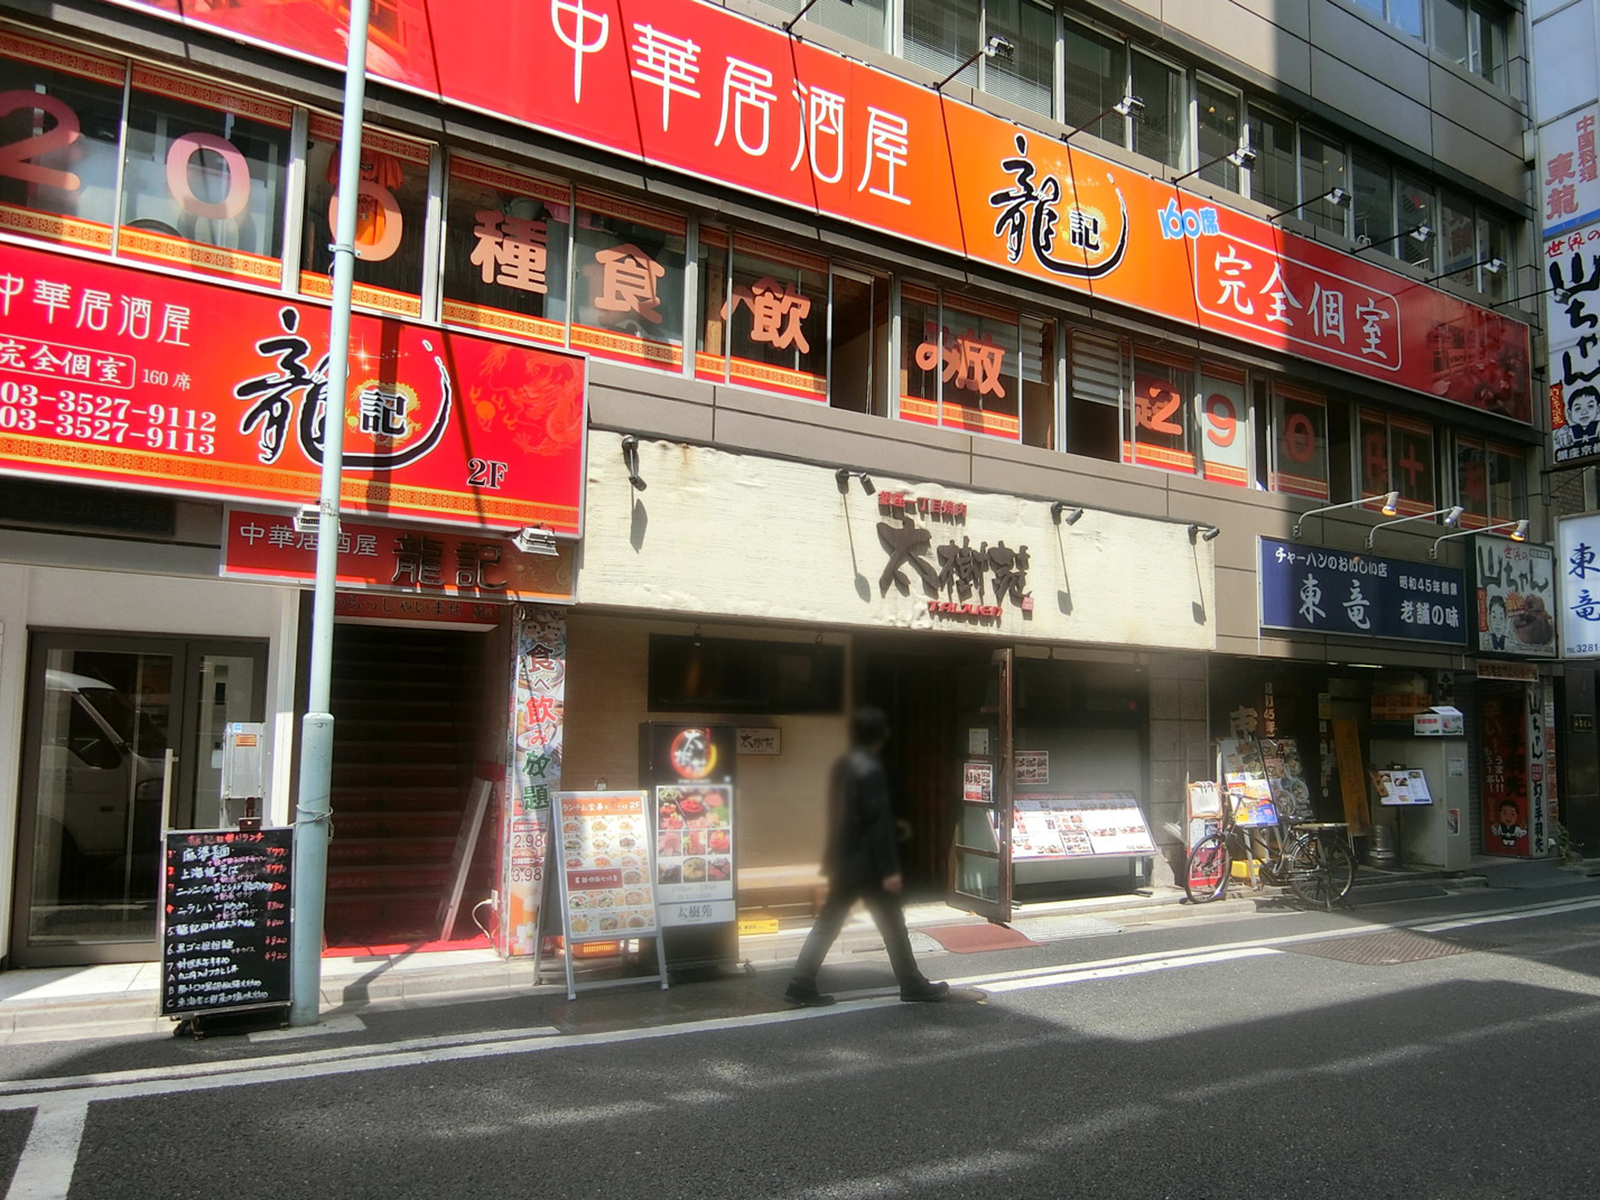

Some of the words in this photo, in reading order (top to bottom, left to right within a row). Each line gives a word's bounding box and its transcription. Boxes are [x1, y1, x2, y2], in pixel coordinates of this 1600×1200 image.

[550, 0, 912, 206] 中華居酒屋
[1576, 115, 1599, 184] 中国料理
[989, 133, 1129, 280] 龍記
[1545, 151, 1579, 221] 東龍
[1158, 197, 1221, 240] 160席
[0, 273, 191, 347] 中華居酒屋
[1212, 244, 1392, 362] 完全個室
[1549, 251, 1600, 387] 山ちゃん
[0, 339, 127, 384] 完全個室
[142, 369, 168, 386] 160
[172, 373, 192, 391] 席
[0, 381, 217, 432] 03-3527-9112
[0, 405, 215, 456] 03-3527-9113
[467, 459, 508, 490] 2F
[391, 534, 508, 589] 龍記
[1275, 546, 1388, 578] チャーハンのおいしい店
[1478, 544, 1550, 593] 山ちゃん
[1568, 542, 1600, 622] 東竜
[1298, 573, 1371, 630] 東竜
[1400, 600, 1459, 629] 老舗の味
[522, 643, 557, 811] 食べ飲み放題
[677, 905, 713, 919] 太樹苑
